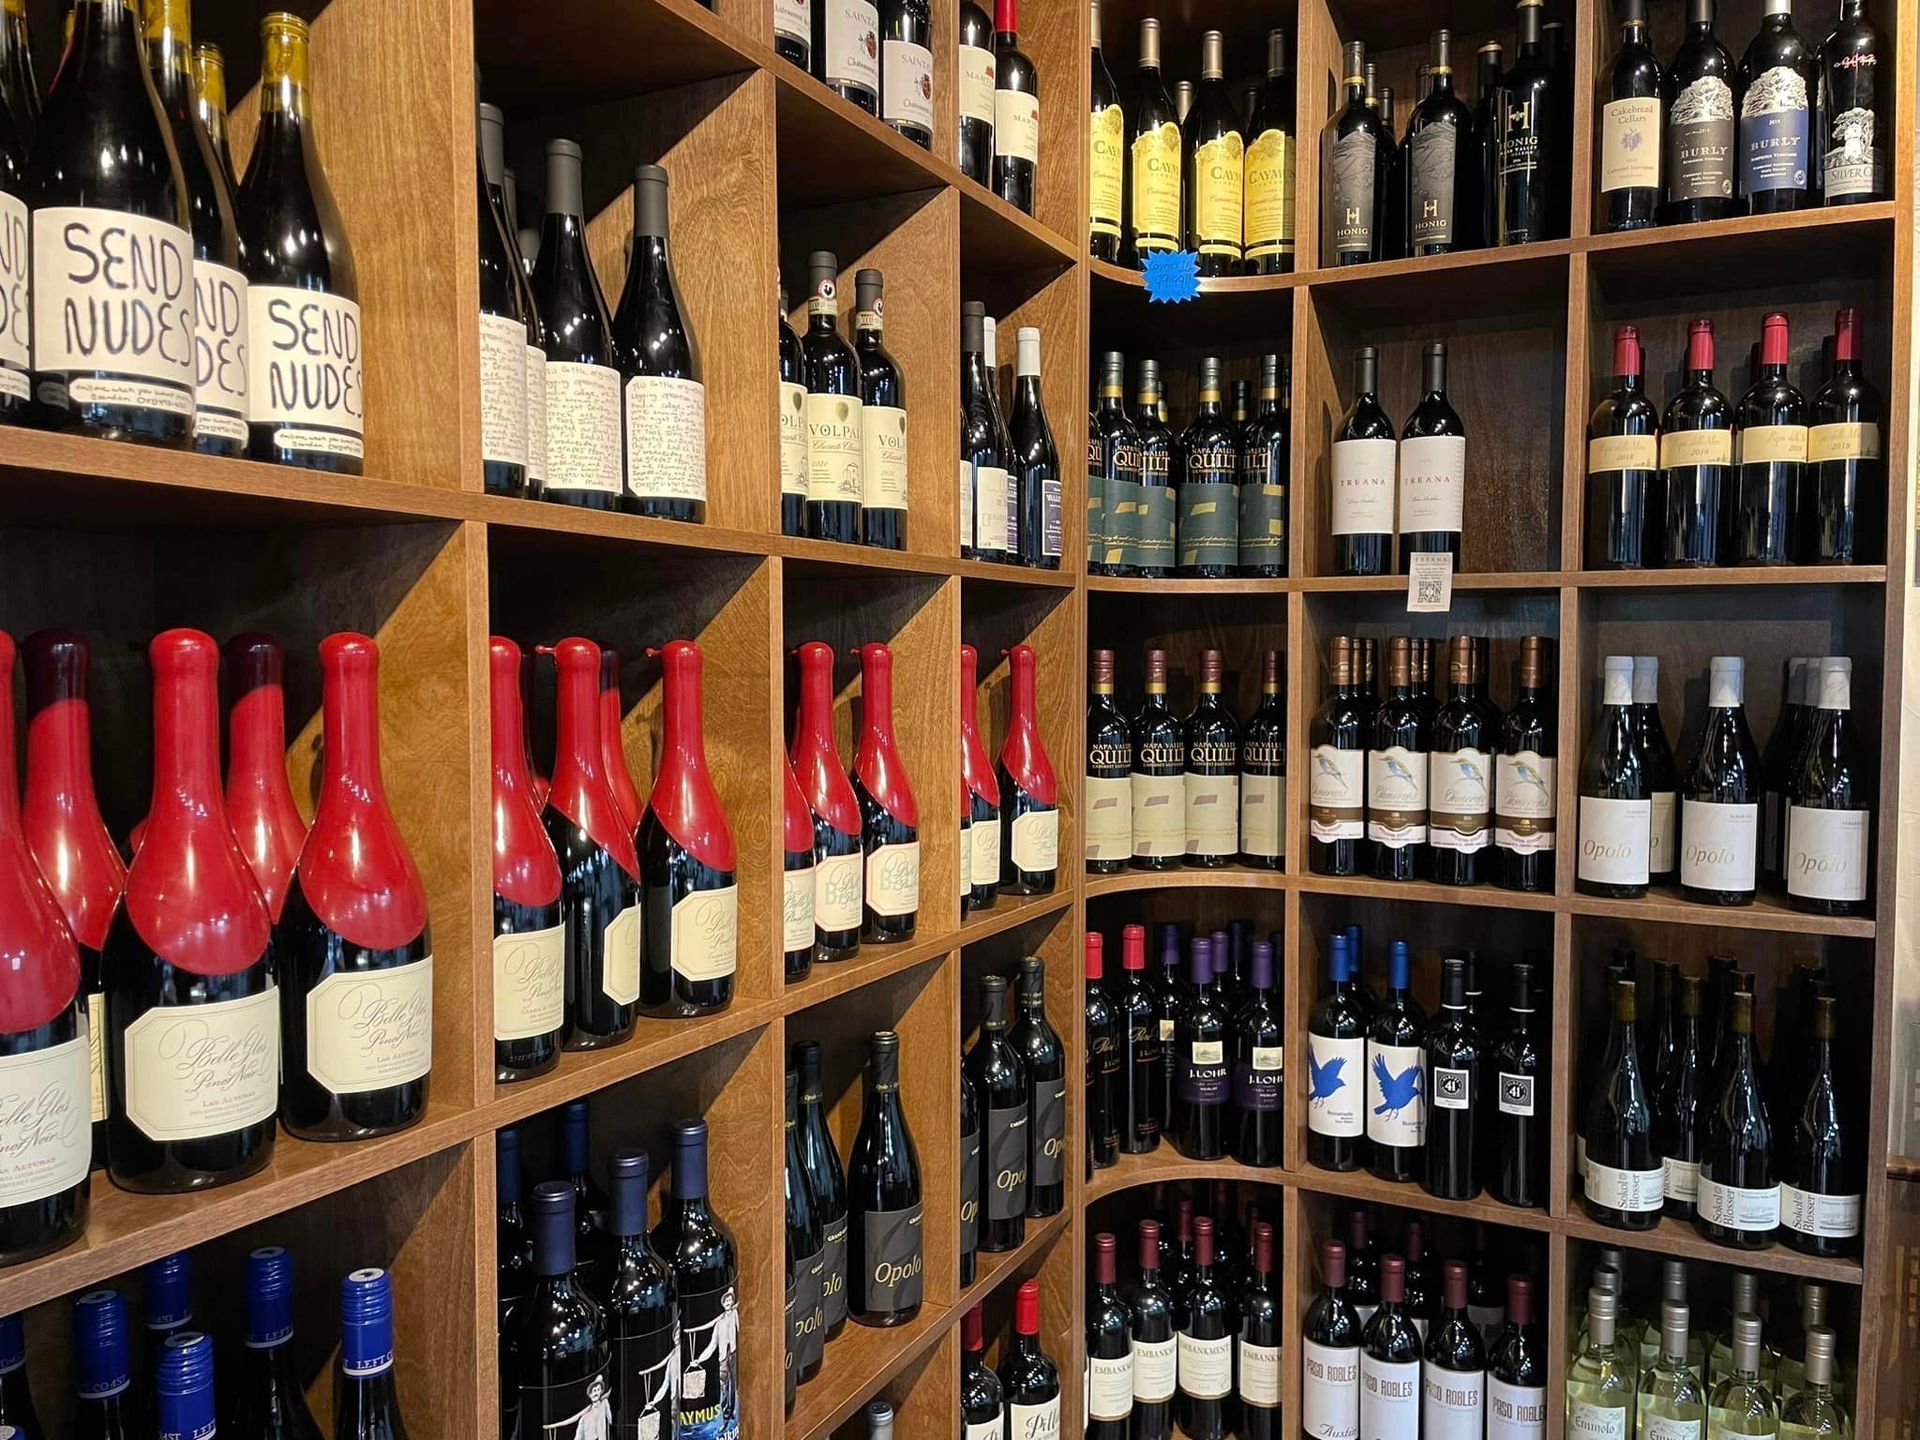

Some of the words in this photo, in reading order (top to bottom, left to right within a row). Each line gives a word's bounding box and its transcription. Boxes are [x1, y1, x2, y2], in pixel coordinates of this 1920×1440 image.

[1611, 104, 1653, 117] Cakebread
[1618, 114, 1647, 125] Cellars
[1681, 146, 1728, 159] BURLY
[1751, 136, 1801, 151] BURLY
[1832, 165, 1862, 182] SILVER
[1337, 227, 1368, 237] HONIG
[1415, 219, 1447, 230] HONIG
[63, 222, 183, 301] SEND
[64, 295, 191, 367] NUDES
[268, 299, 358, 364] SEND
[1189, 452, 1236, 469] QUILT
[1339, 478, 1386, 487] TREANA
[1403, 475, 1450, 485] TREANA
[1190, 748, 1236, 762] QUILT
[1584, 839, 1632, 861] Opolo
[1685, 844, 1735, 866] Opolo
[1795, 851, 1847, 875] Opolo
[187, 1069, 235, 1094] Pinot
[1444, 1080, 1456, 1092] 41
[1509, 1086, 1520, 1098] 41
[1617, 1180, 1629, 1209] Sokol
[1629, 1173, 1640, 1210] Blosser
[1712, 1192, 1723, 1223] Sokol
[1723, 1188, 1735, 1227] Blosser
[1792, 1199, 1803, 1230] Sokol
[1803, 1194, 1816, 1232] Blosser
[874, 1253, 922, 1288] Opolo
[356, 1354, 385, 1370] LEFT
[1306, 1358, 1323, 1379] PASO
[1327, 1365, 1357, 1382] ROBLES
[1381, 1380, 1413, 1398] ROBLES
[1446, 1388, 1478, 1407] ROBLES
[1492, 1396, 1513, 1420] PASO
